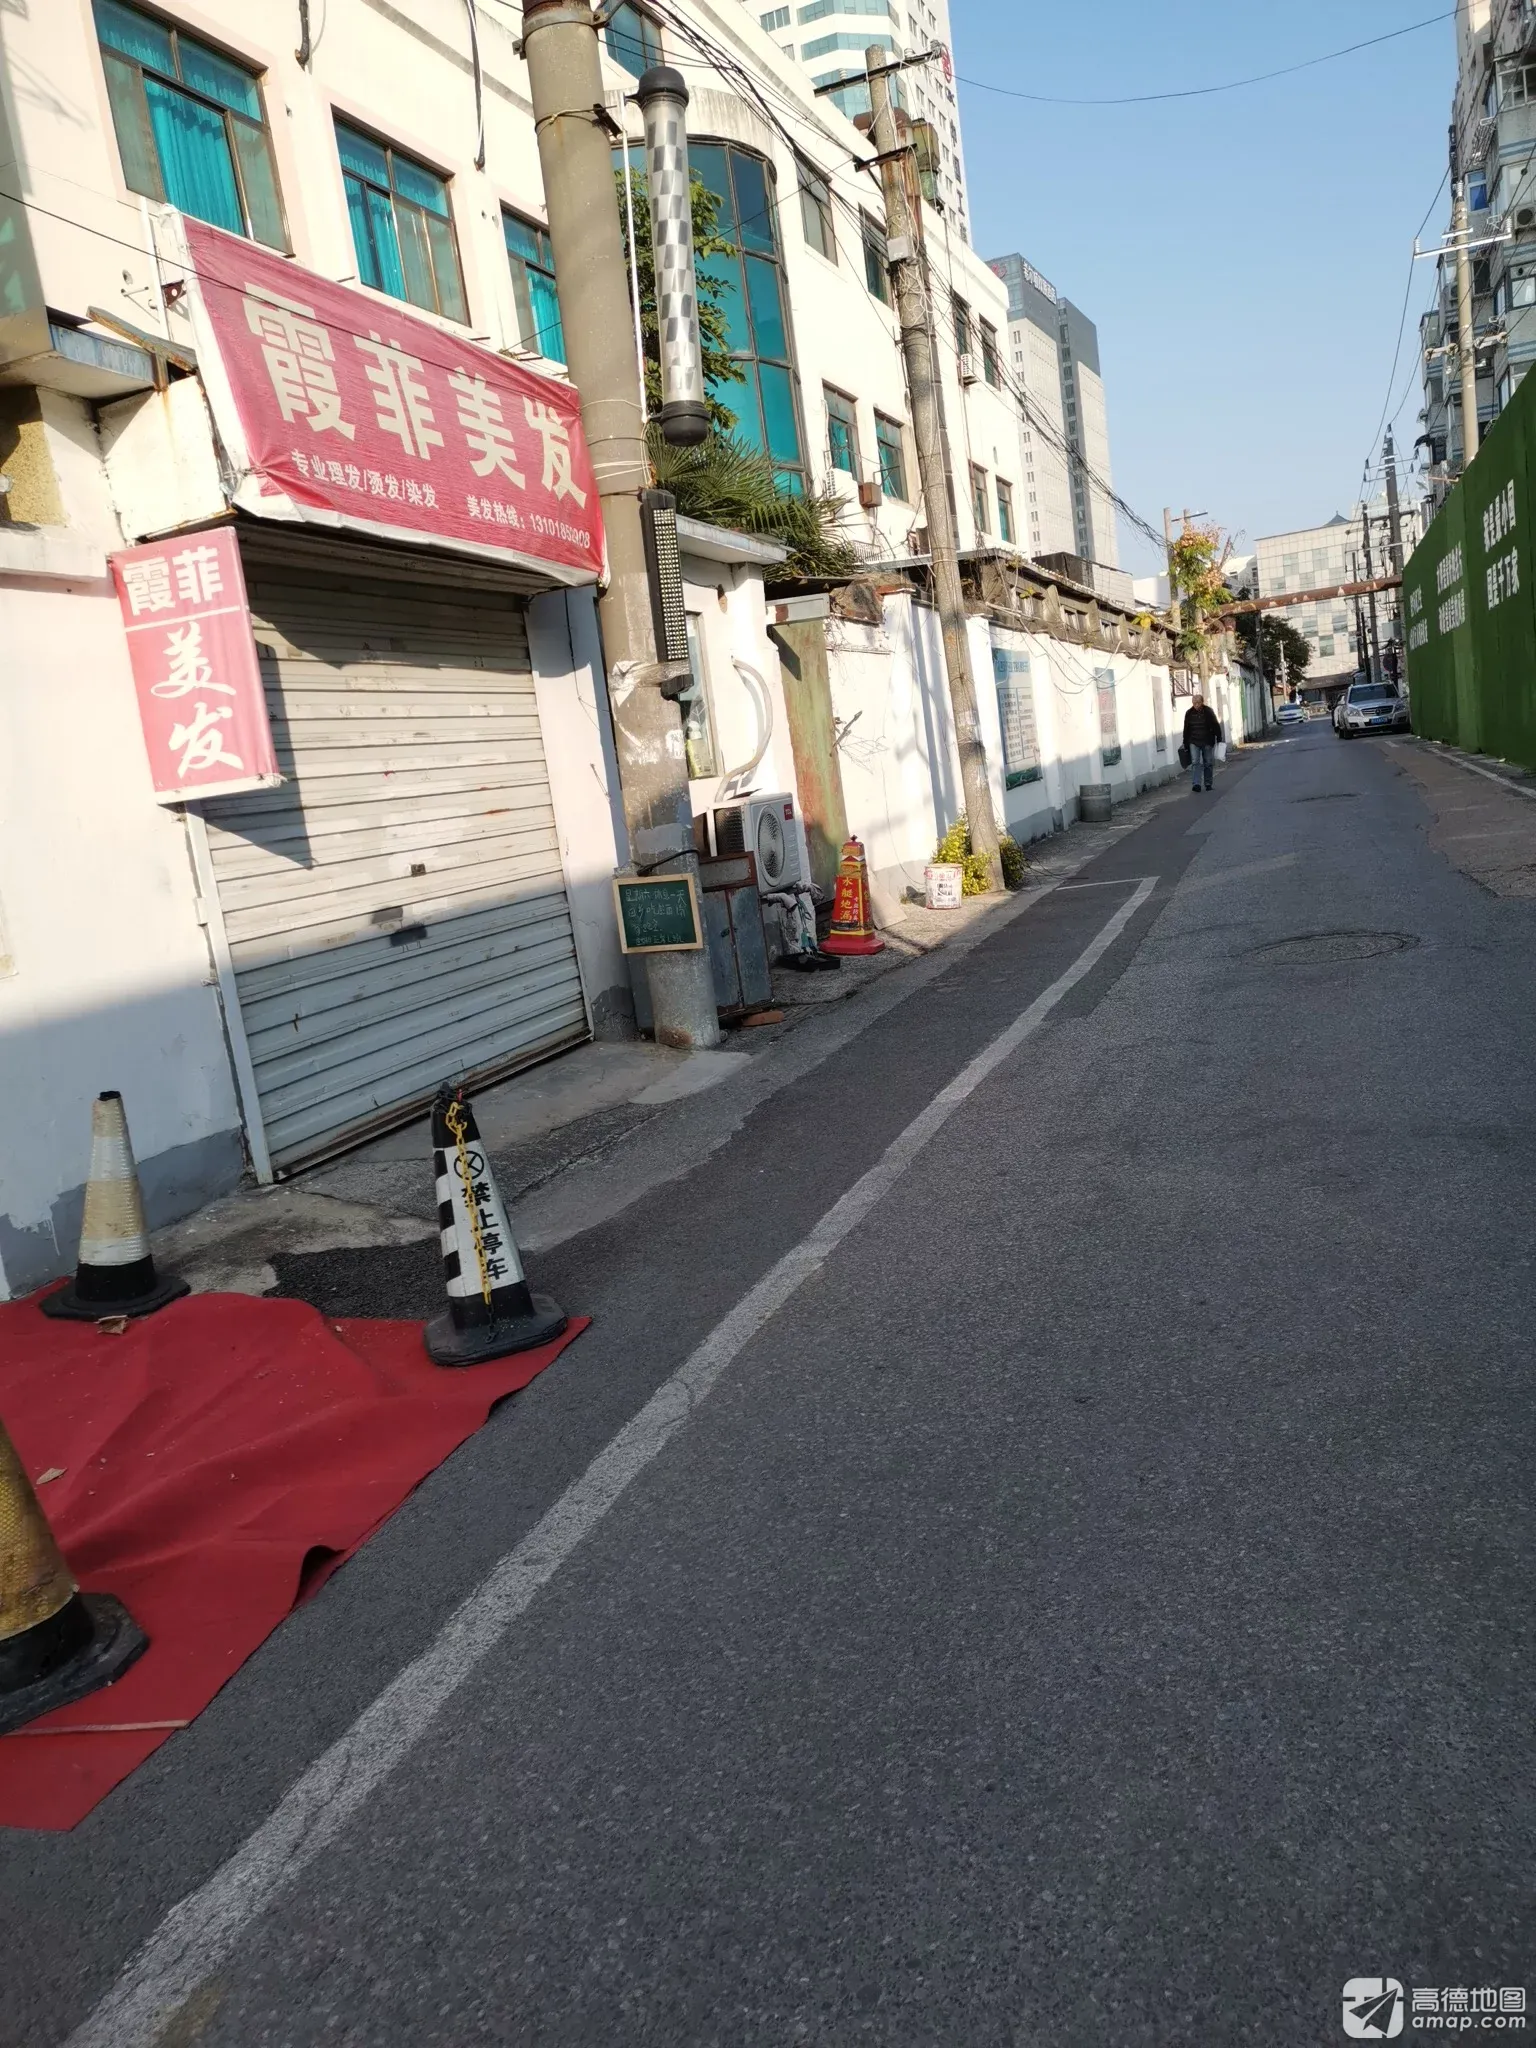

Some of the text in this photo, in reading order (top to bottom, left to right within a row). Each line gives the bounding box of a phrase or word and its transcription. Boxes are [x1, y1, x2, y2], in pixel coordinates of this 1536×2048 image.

[242, 282, 588, 509] 霞菲美发
[1482, 479, 1516, 553] 家是最小国
[122, 546, 225, 615] 霞菲
[1486, 546, 1520, 611] 国是千万家
[151, 621, 244, 779] 美发
